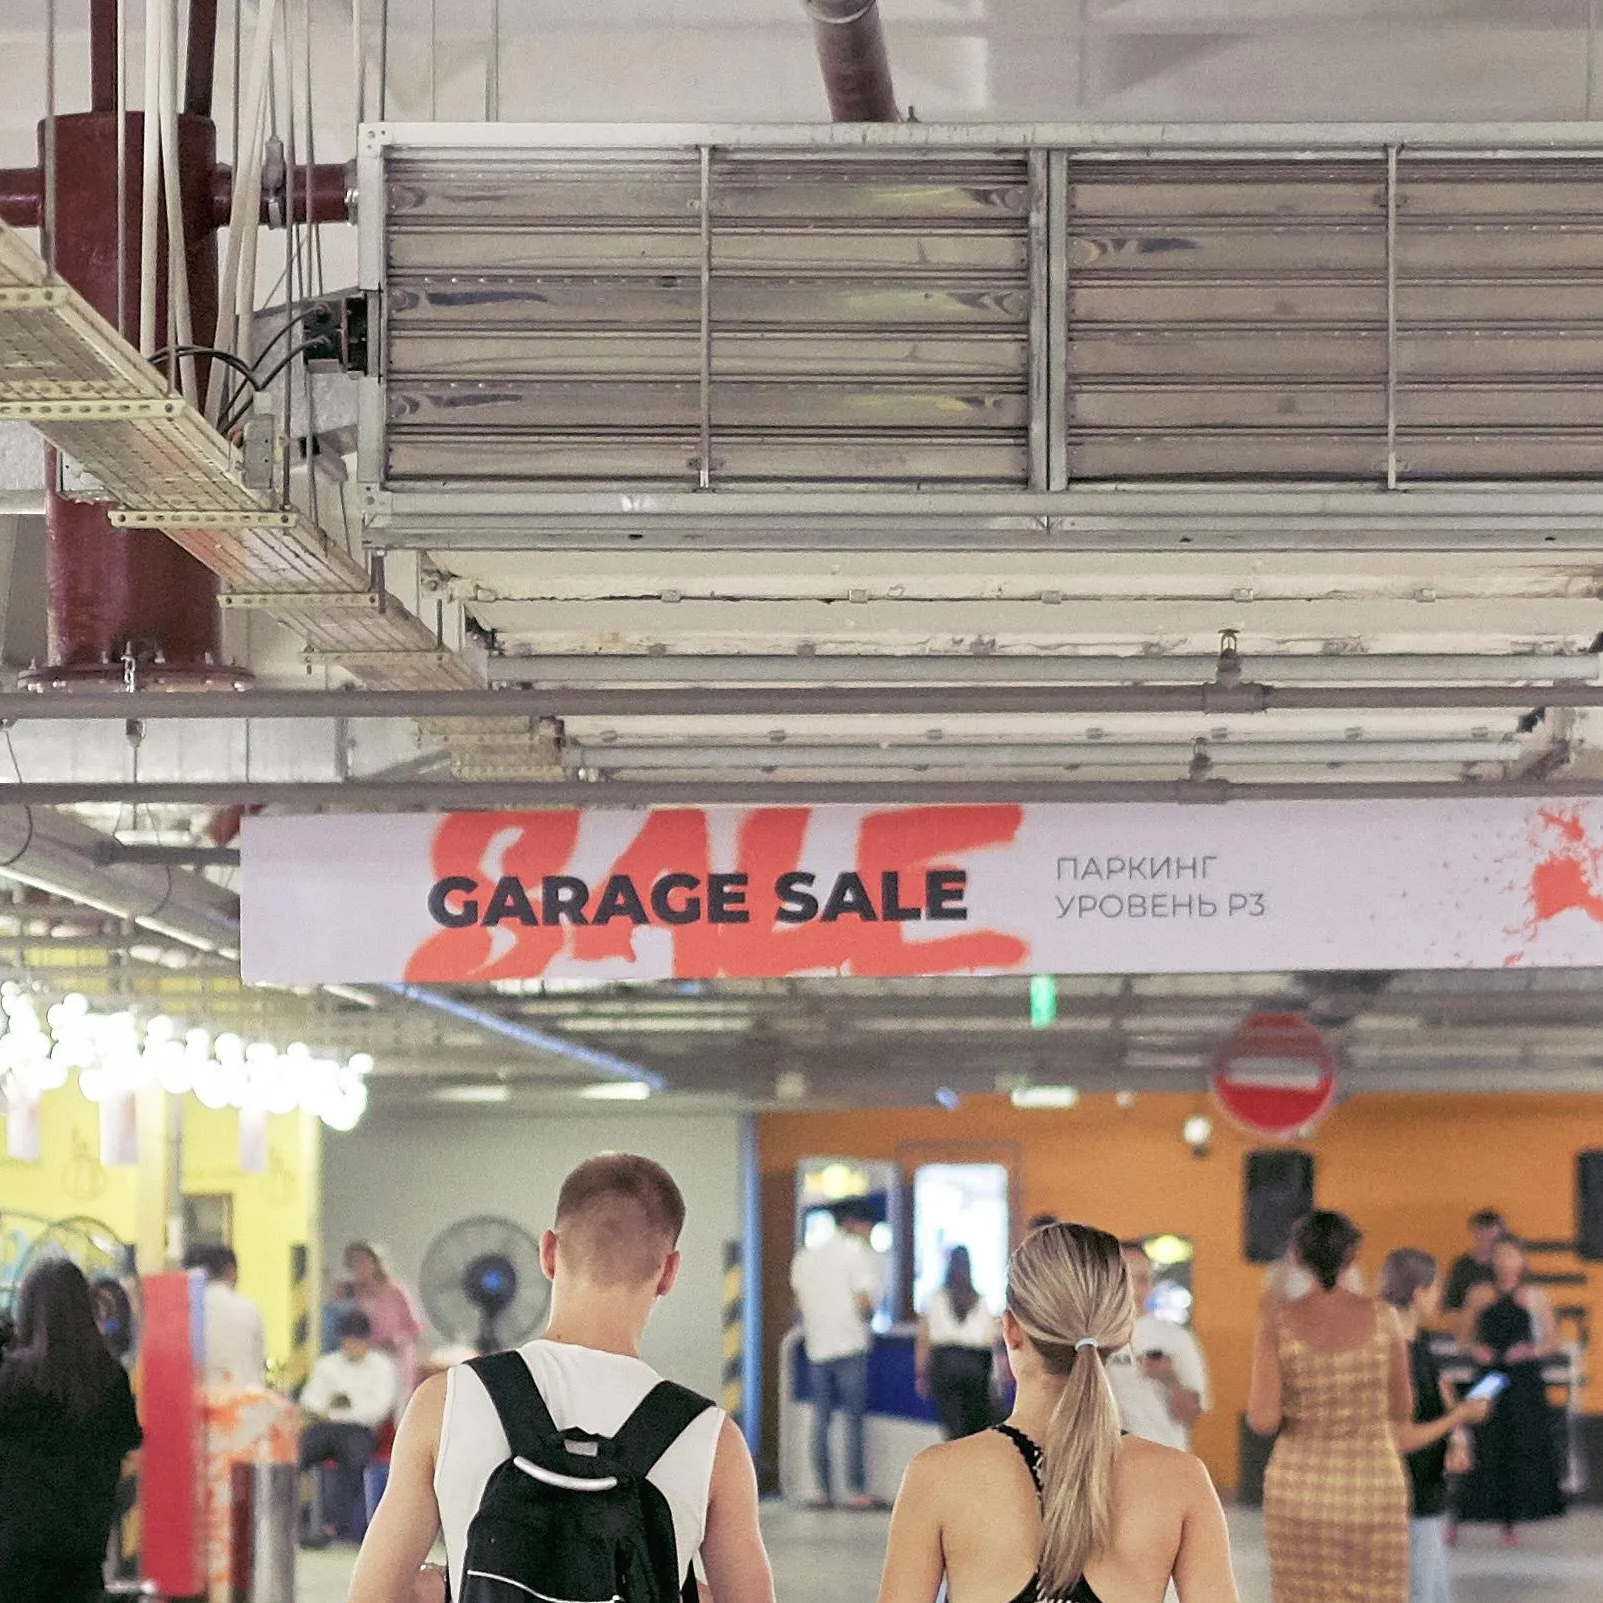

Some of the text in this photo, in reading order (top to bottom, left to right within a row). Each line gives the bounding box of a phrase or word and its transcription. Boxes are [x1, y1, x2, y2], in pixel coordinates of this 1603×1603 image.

[1056, 855, 1218, 881] ПАРКИНГ
[427, 870, 968, 928] GARAGE SALE
[1055, 893, 1217, 919] УРОВЕНЬ
